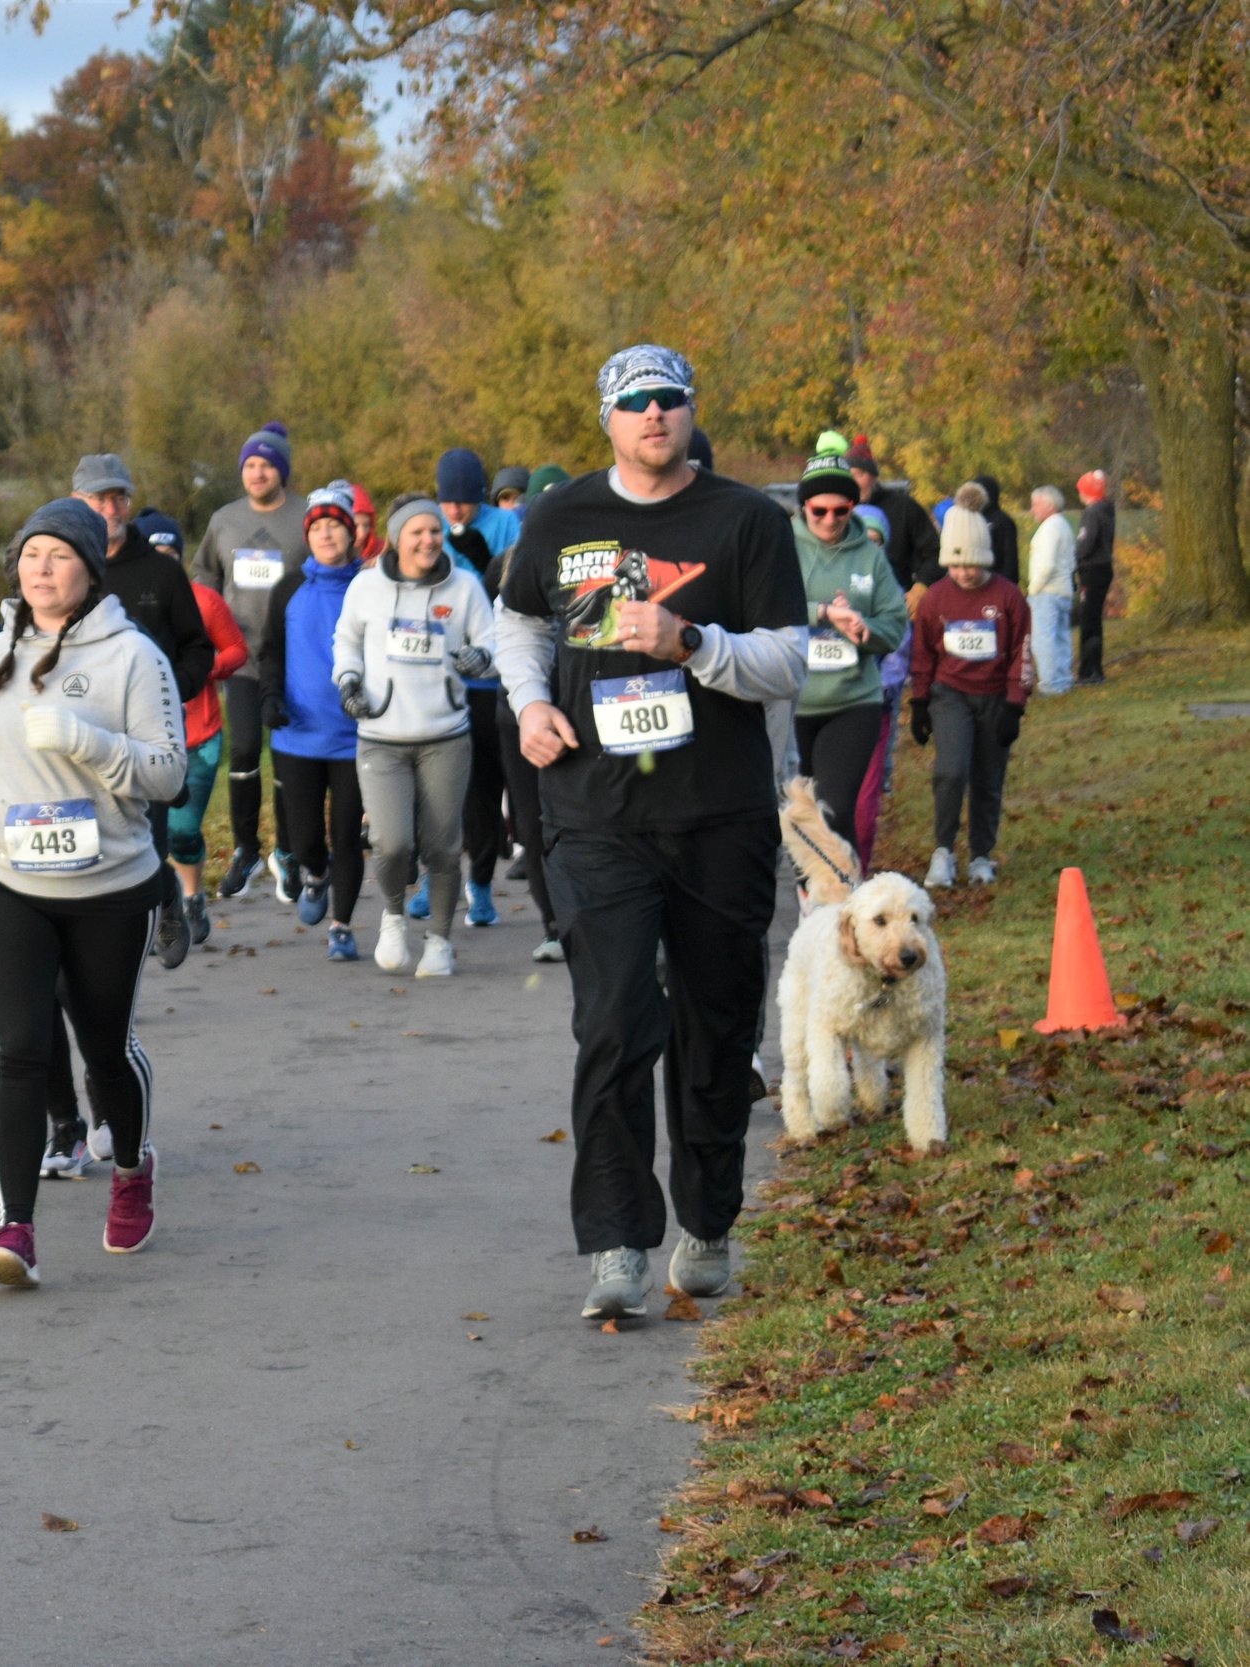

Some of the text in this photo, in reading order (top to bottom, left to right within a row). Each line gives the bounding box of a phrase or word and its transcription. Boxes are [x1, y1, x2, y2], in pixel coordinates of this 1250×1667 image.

[561, 550, 617, 571] DARTH
[559, 564, 616, 585] GATOR
[814, 643, 843, 660] 485
[620, 704, 669, 735] 480
[30, 829, 77, 855] 443
